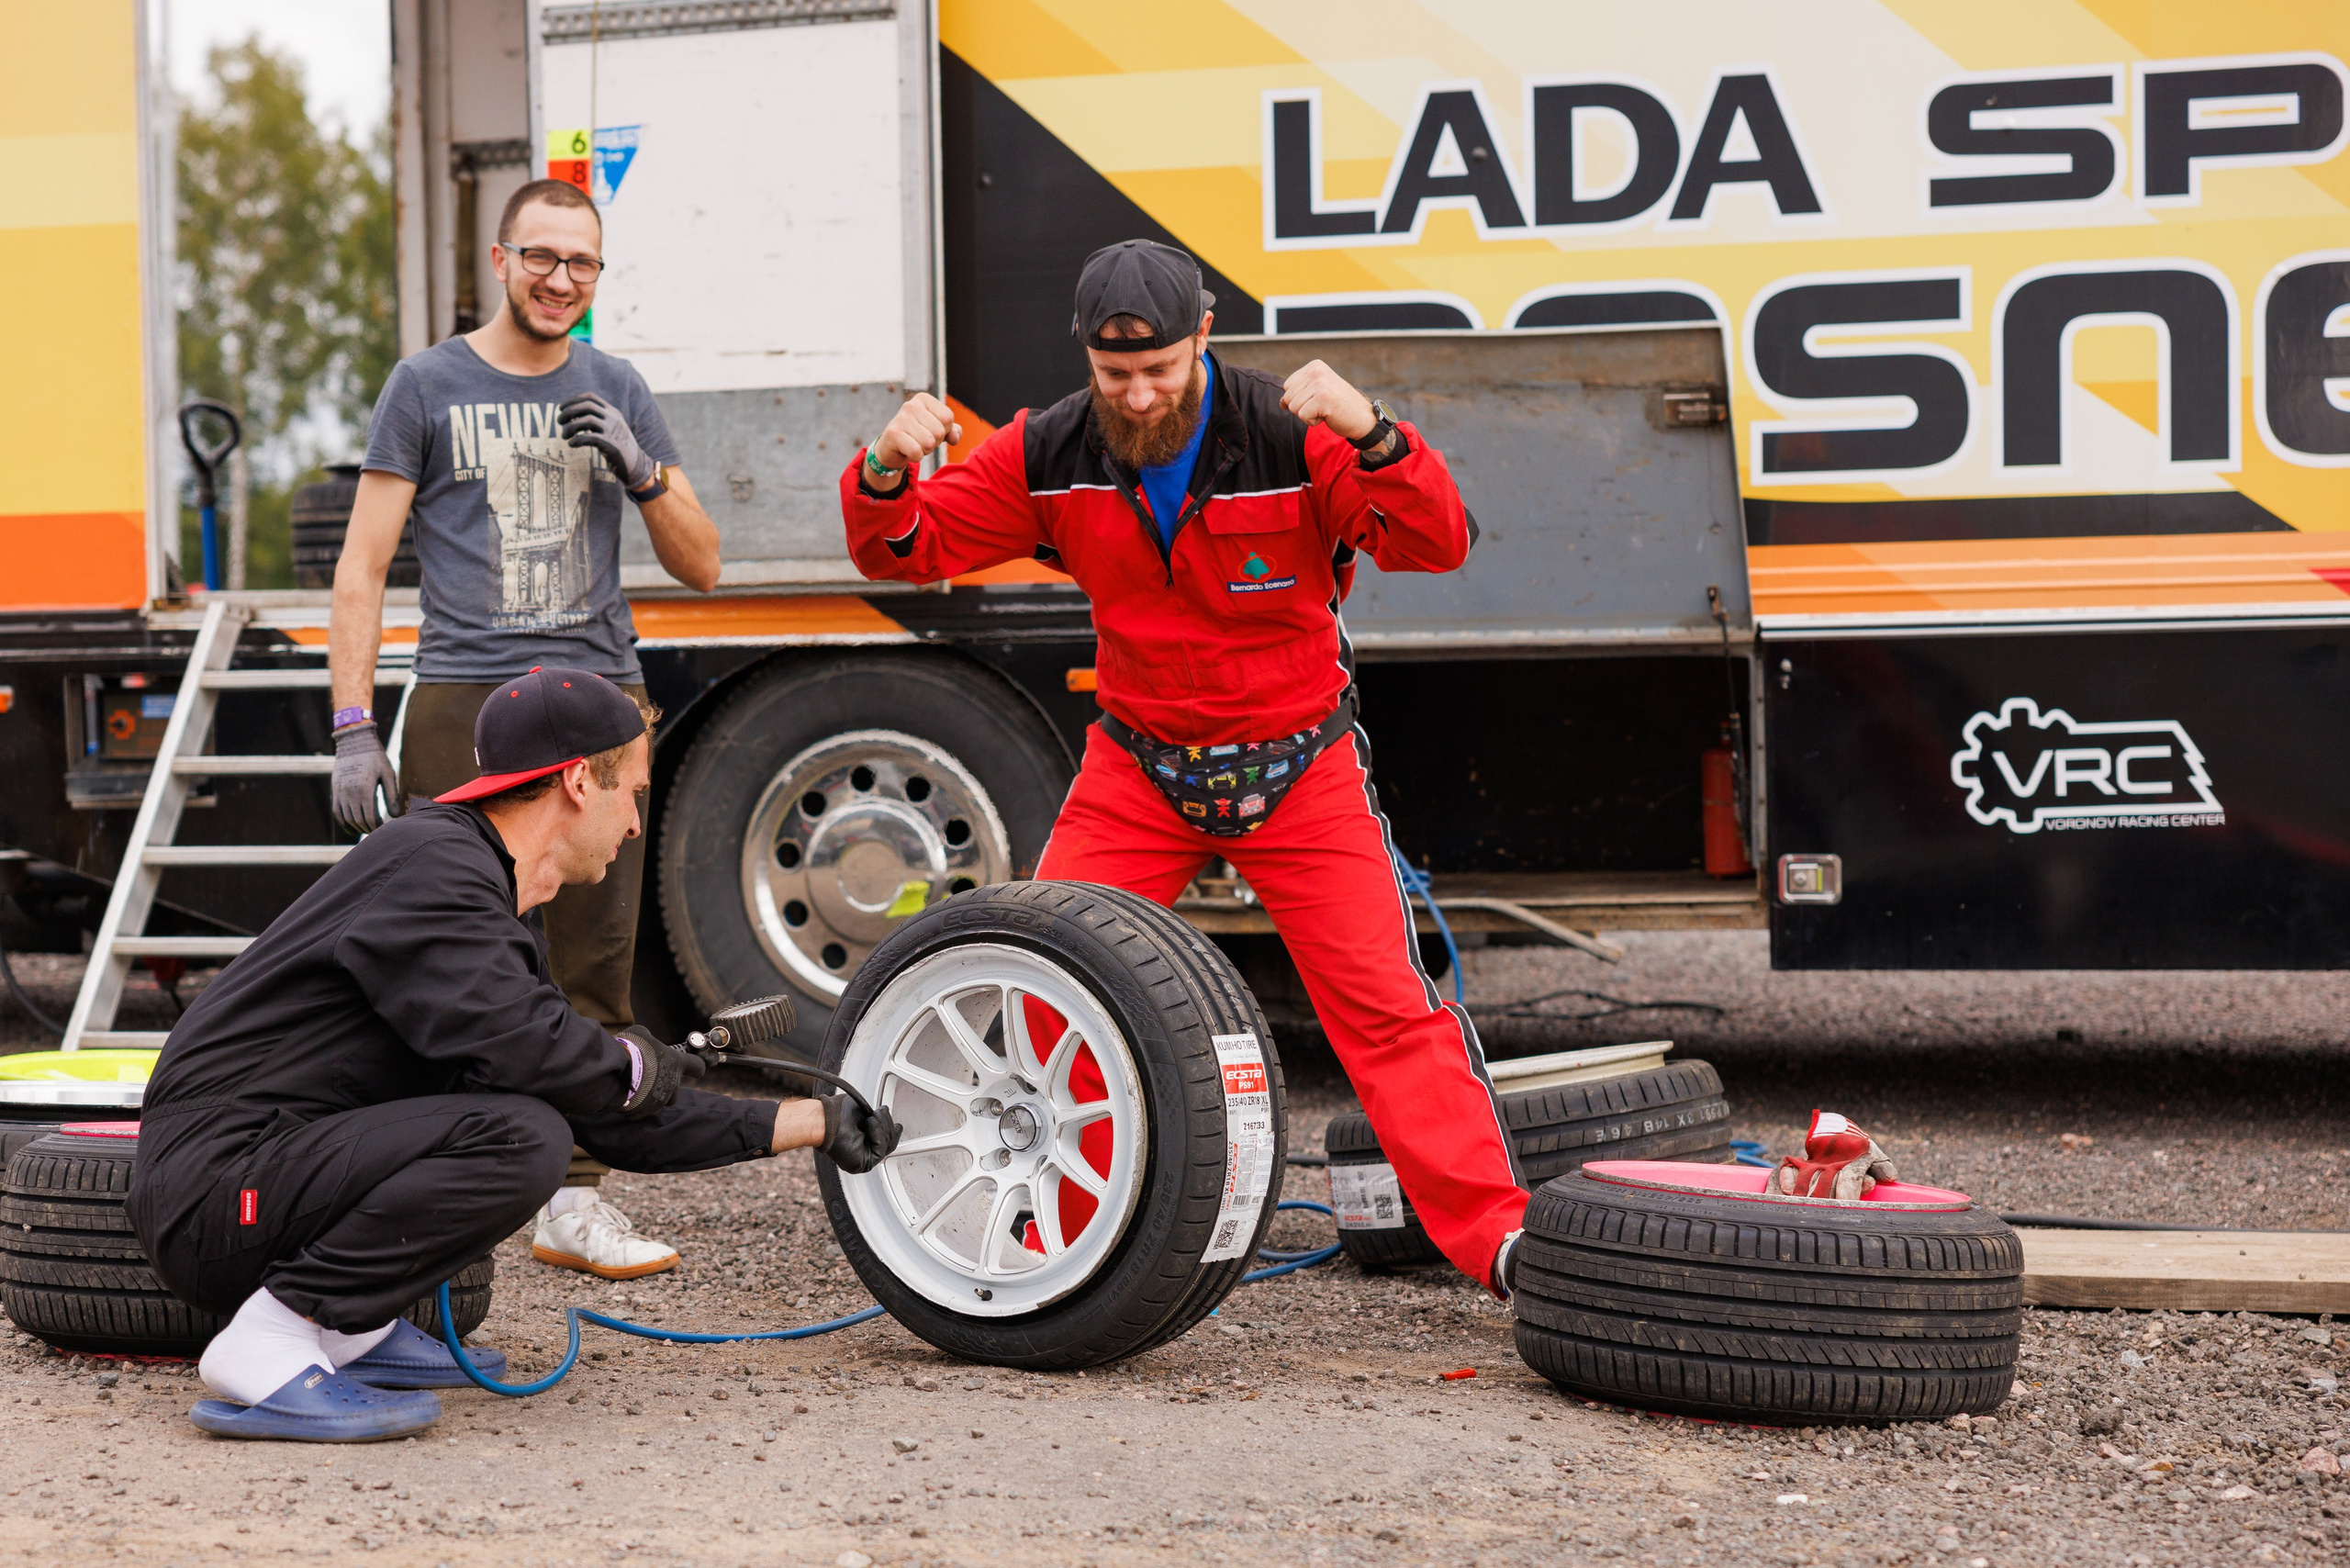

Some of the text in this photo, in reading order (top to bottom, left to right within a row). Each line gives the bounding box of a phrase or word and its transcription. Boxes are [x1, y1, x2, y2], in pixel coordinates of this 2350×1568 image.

[572, 130, 587, 154] 6
[1269, 55, 2348, 245] LADA SP
[573, 161, 586, 184] 8
[454, 467, 487, 482] CITY OF
[1230, 583, 1264, 592] Bernardo
[1991, 745, 2173, 798] VRC
[2043, 812, 2226, 831] VORONOV RACING CENTER
[1238, 1081, 1255, 1090] PS91
